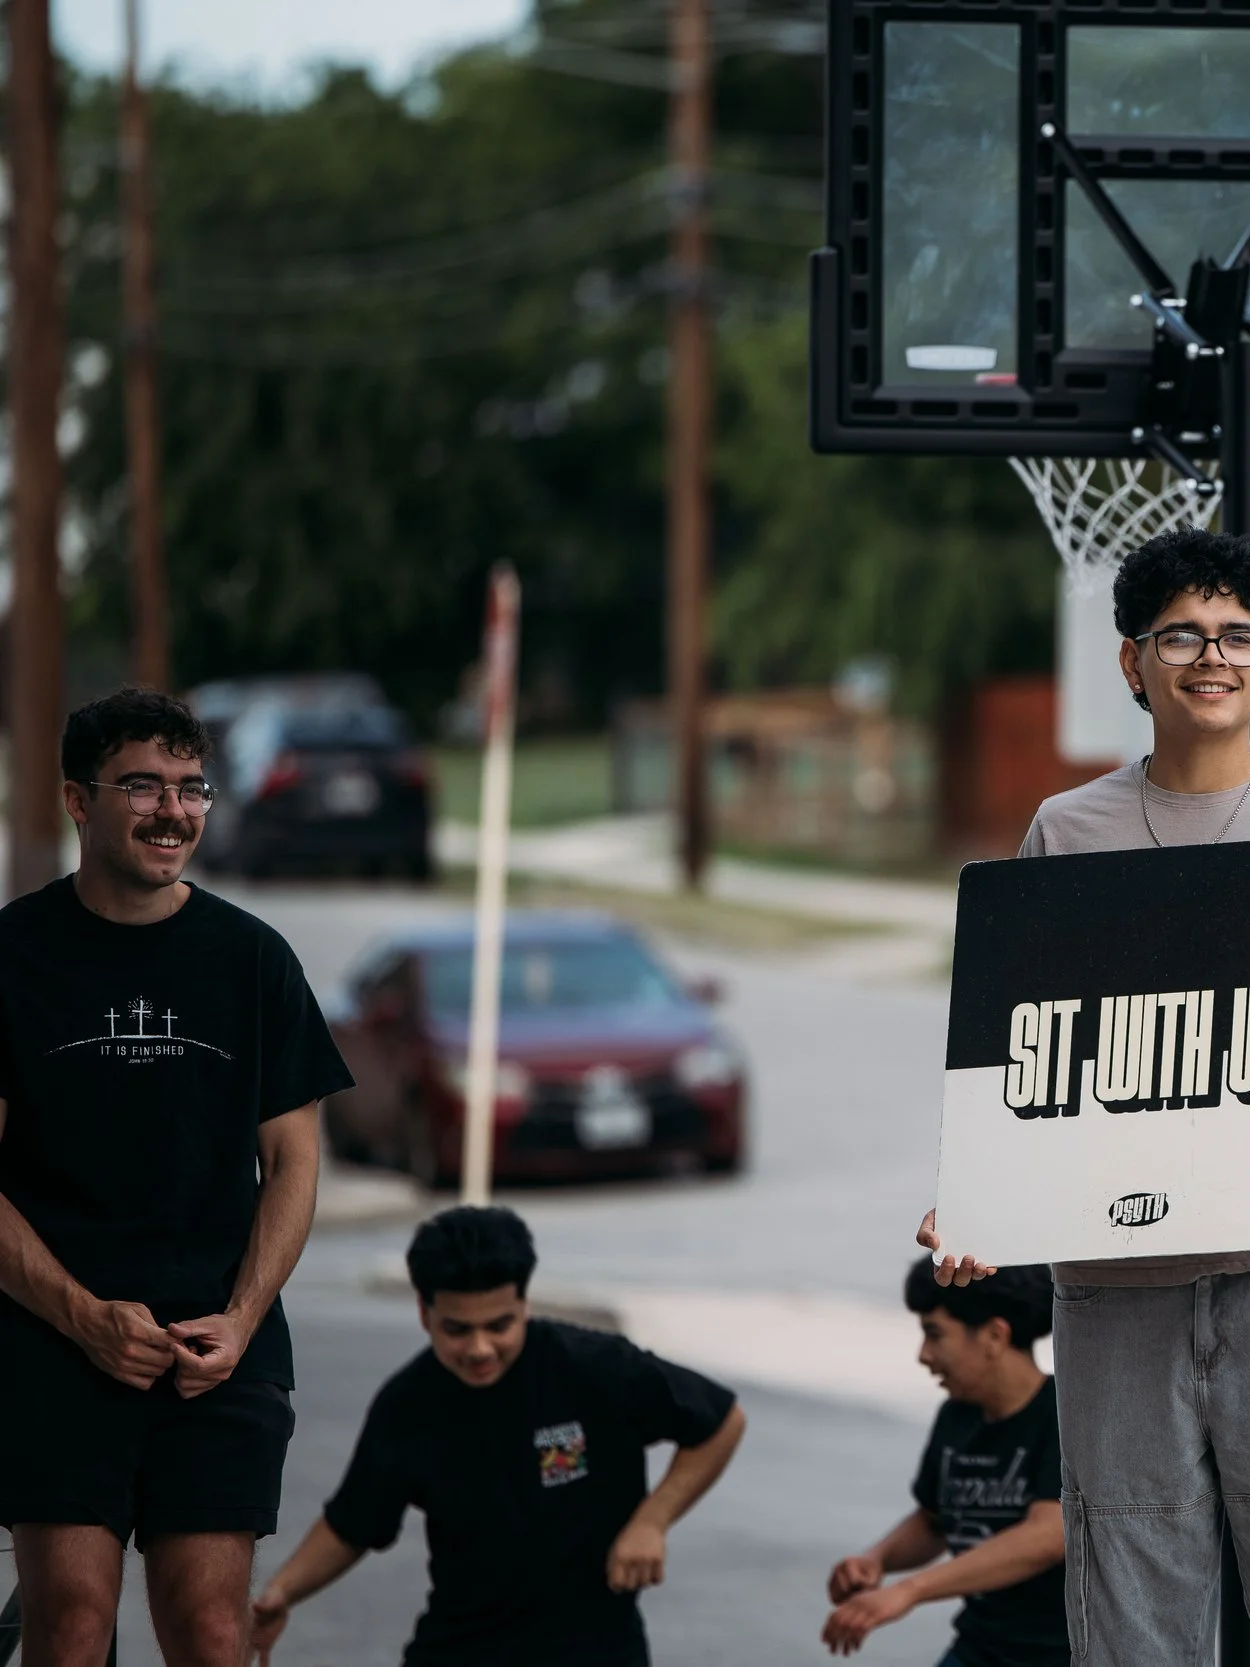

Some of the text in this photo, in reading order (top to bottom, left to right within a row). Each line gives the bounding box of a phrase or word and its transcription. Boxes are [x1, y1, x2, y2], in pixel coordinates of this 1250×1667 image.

[101, 1045, 184, 1056] IT IS FINISHED
[1005, 999, 1081, 1109] SIT
[1095, 990, 1215, 1102] WITH
